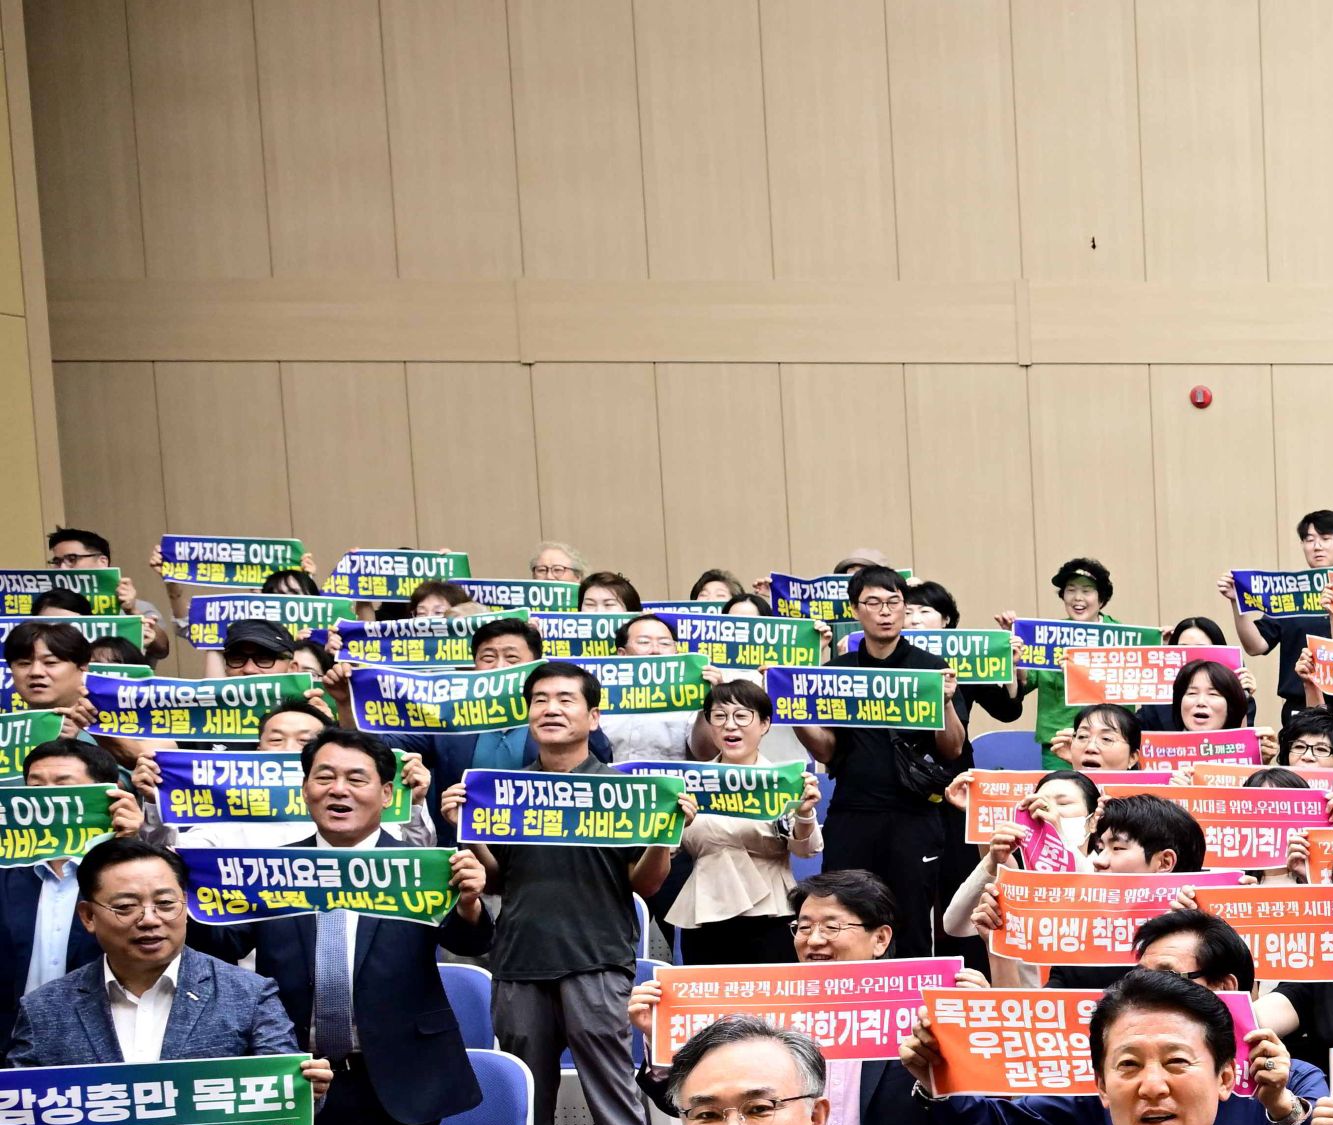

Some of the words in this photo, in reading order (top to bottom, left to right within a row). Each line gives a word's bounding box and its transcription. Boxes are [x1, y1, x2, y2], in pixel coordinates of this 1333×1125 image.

[175, 541, 245, 562] 바가지요금
[251, 544, 291, 563] OUT!
[205, 601, 281, 621] 바가지요금
[285, 603, 332, 621] OUT!
[117, 684, 216, 708] 바가지요금
[222, 682, 281, 706] OUT!
[793, 674, 868, 697] 바가지요금
[873, 676, 918, 698] OUT!
[776, 697, 812, 719] 위생,
[816, 698, 851, 720] 친절,
[857, 700, 901, 721] 서비스
[905, 701, 936, 723] UP!
[494, 779, 593, 807] 바가지요금
[599, 783, 657, 809] OUT!
[472, 808, 516, 835] 위생,
[523, 810, 568, 837] 친절,
[575, 811, 633, 838] 서비스
[638, 812, 677, 838] UP!
[218, 858, 341, 887] 바가지요금
[349, 858, 421, 887] OUT!
[1257, 902, 1299, 918] 관광객
[1265, 932, 1314, 968] 위생!
[724, 981, 770, 998] 관광객
[775, 979, 819, 996] 시대를
[0, 1081, 178, 1125] 감성충만
[193, 1075, 295, 1114] 목포!
